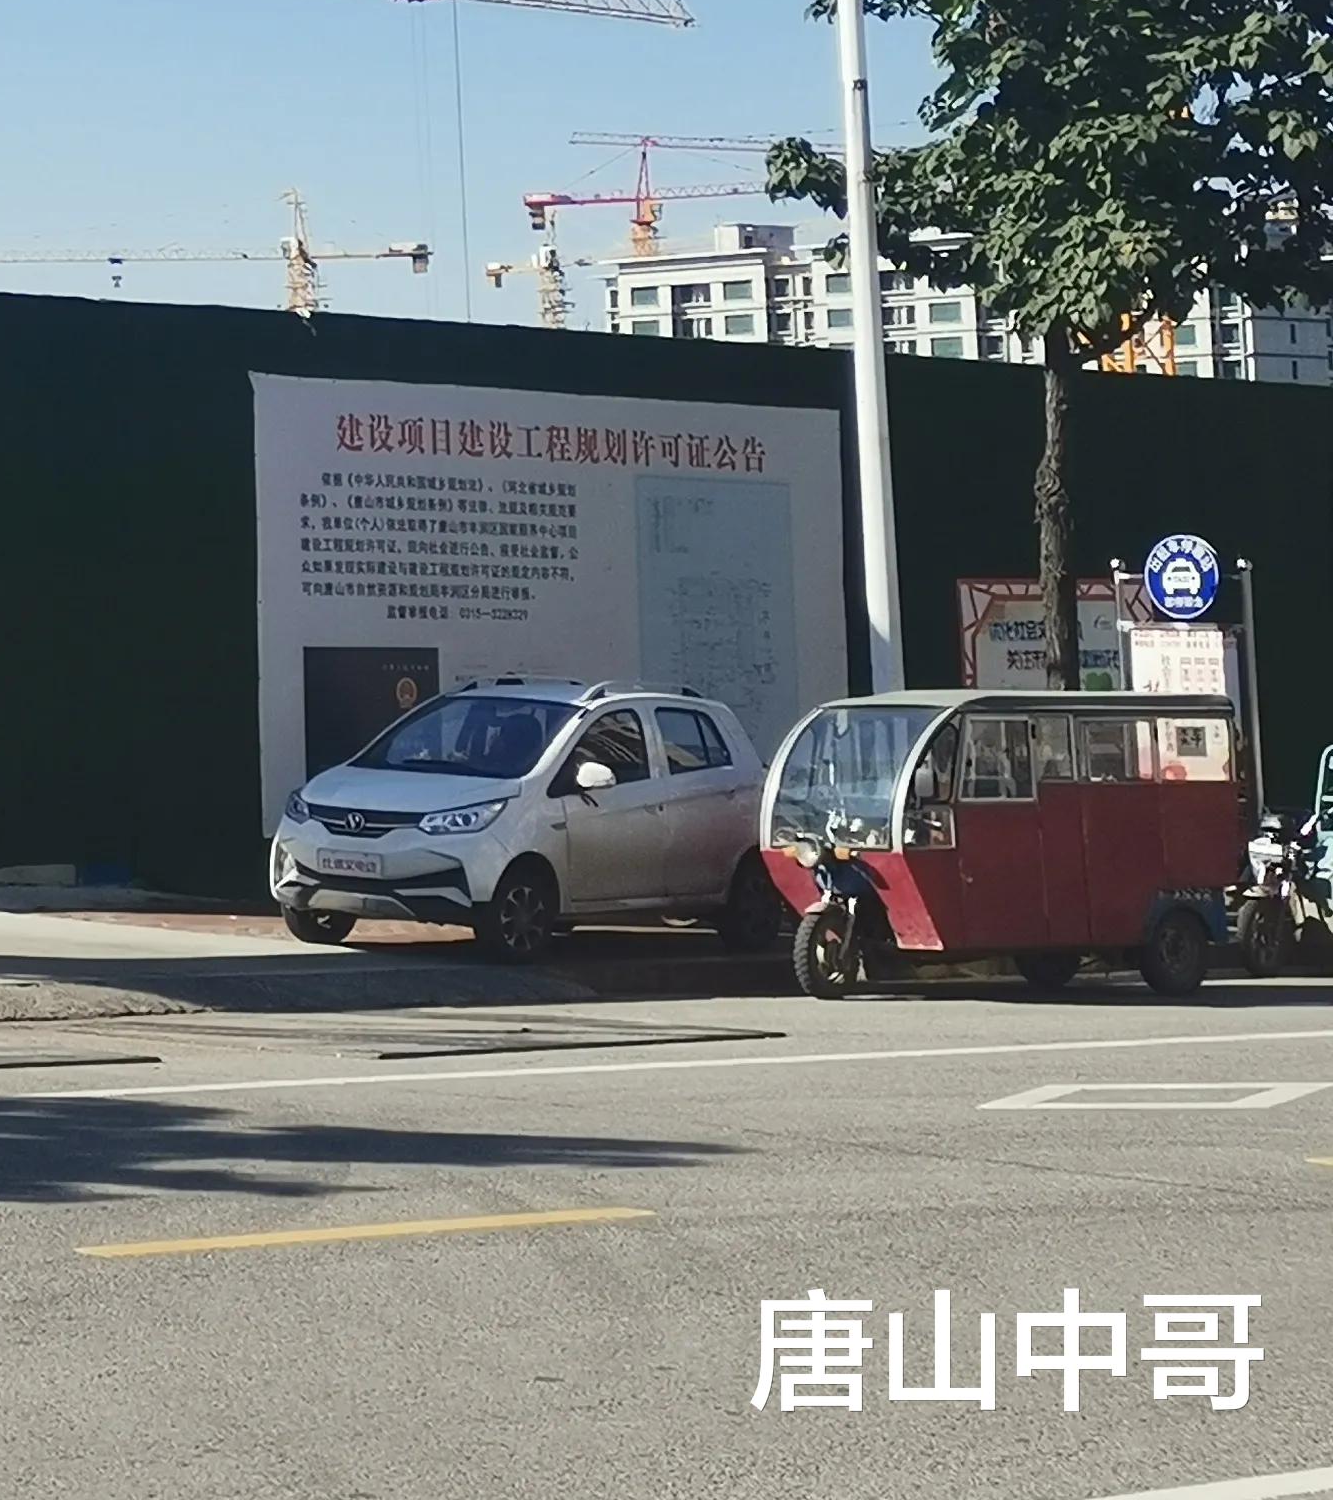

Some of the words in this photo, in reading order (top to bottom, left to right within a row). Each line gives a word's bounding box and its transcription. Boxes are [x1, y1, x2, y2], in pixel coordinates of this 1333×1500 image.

[336, 412, 767, 473] 建设项目建设工程规划许可证公告
